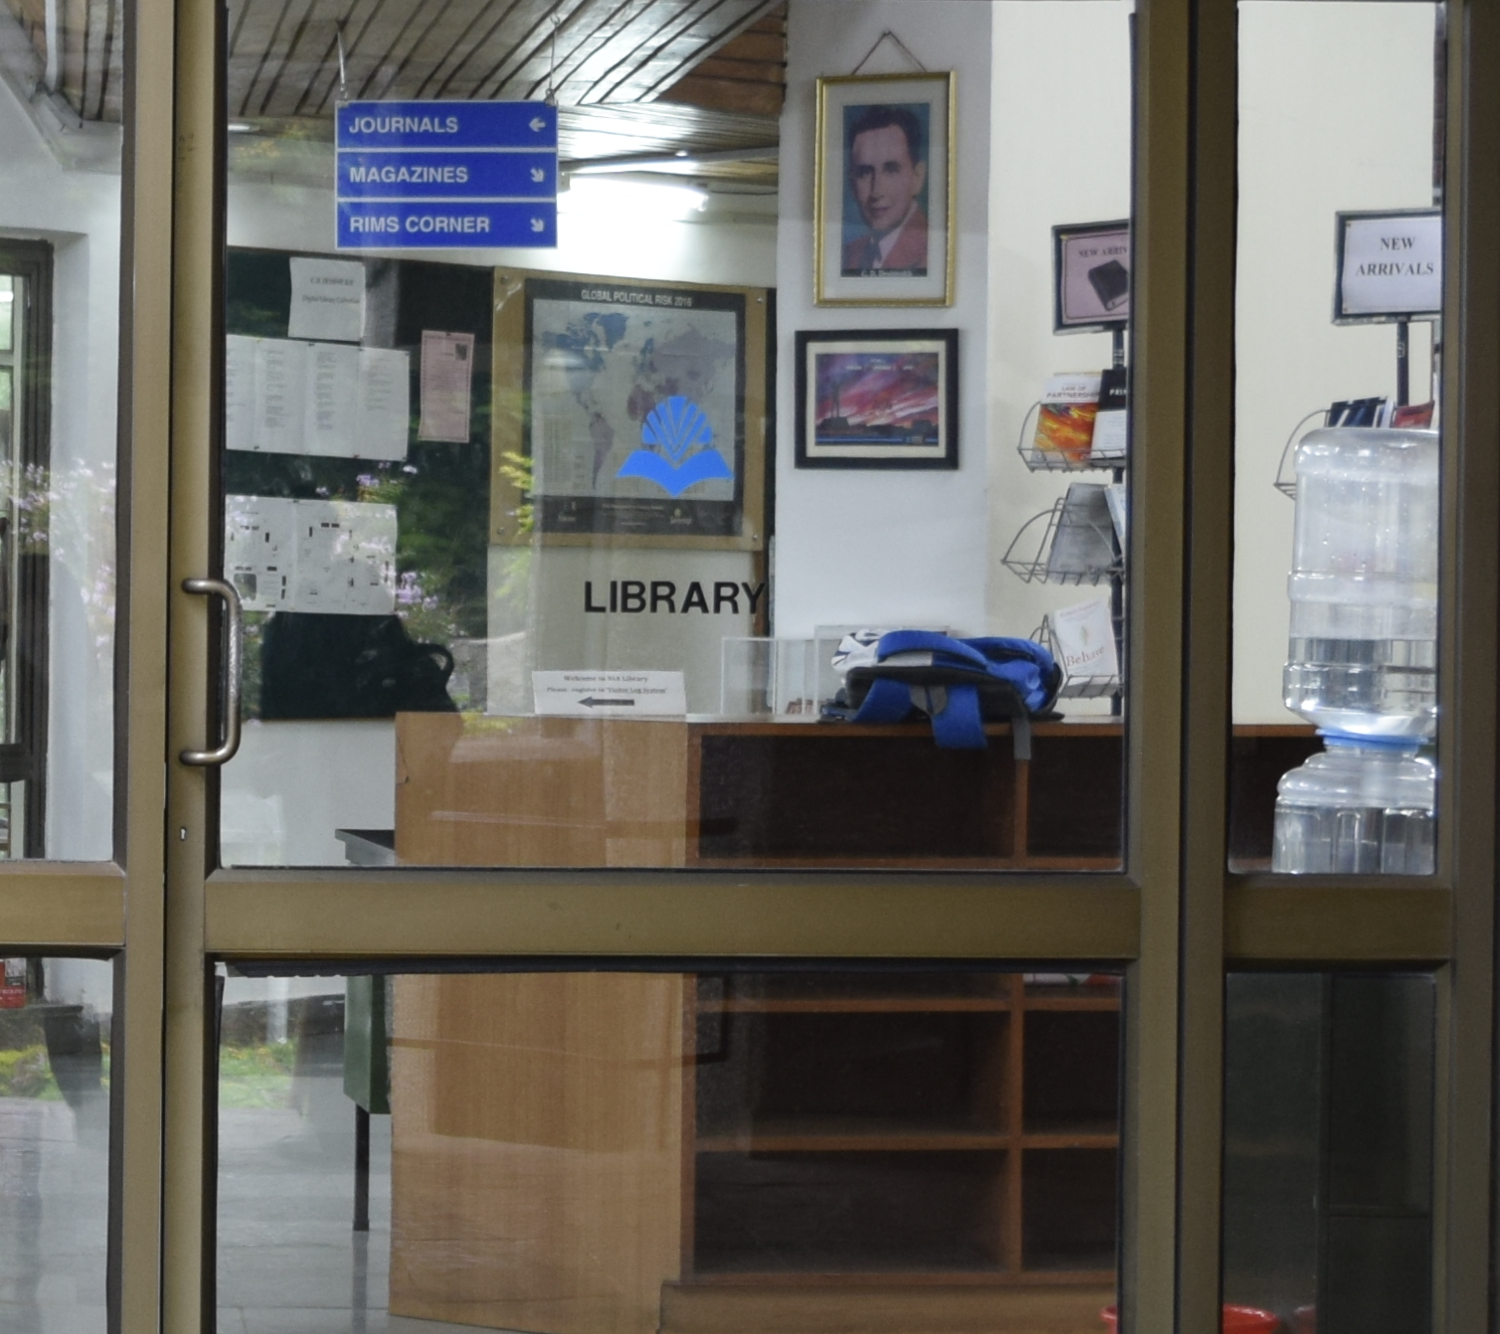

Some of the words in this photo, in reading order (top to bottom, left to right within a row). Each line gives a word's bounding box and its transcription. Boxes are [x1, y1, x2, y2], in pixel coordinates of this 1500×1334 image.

[349, 116, 459, 134] JOURNALS
[349, 166, 470, 183] MAGAZINES
[350, 216, 400, 233] RIMS
[405, 216, 491, 234] CORNER
[1380, 237, 1415, 251] NEW
[1079, 249, 1098, 258] NEW
[1355, 262, 1434, 276] ARRIVALS
[581, 289, 612, 302] GLOBAL
[613, 291, 654, 305] POLITICAL
[655, 294, 673, 306] RISK
[584, 580, 765, 614] LIBRARY
